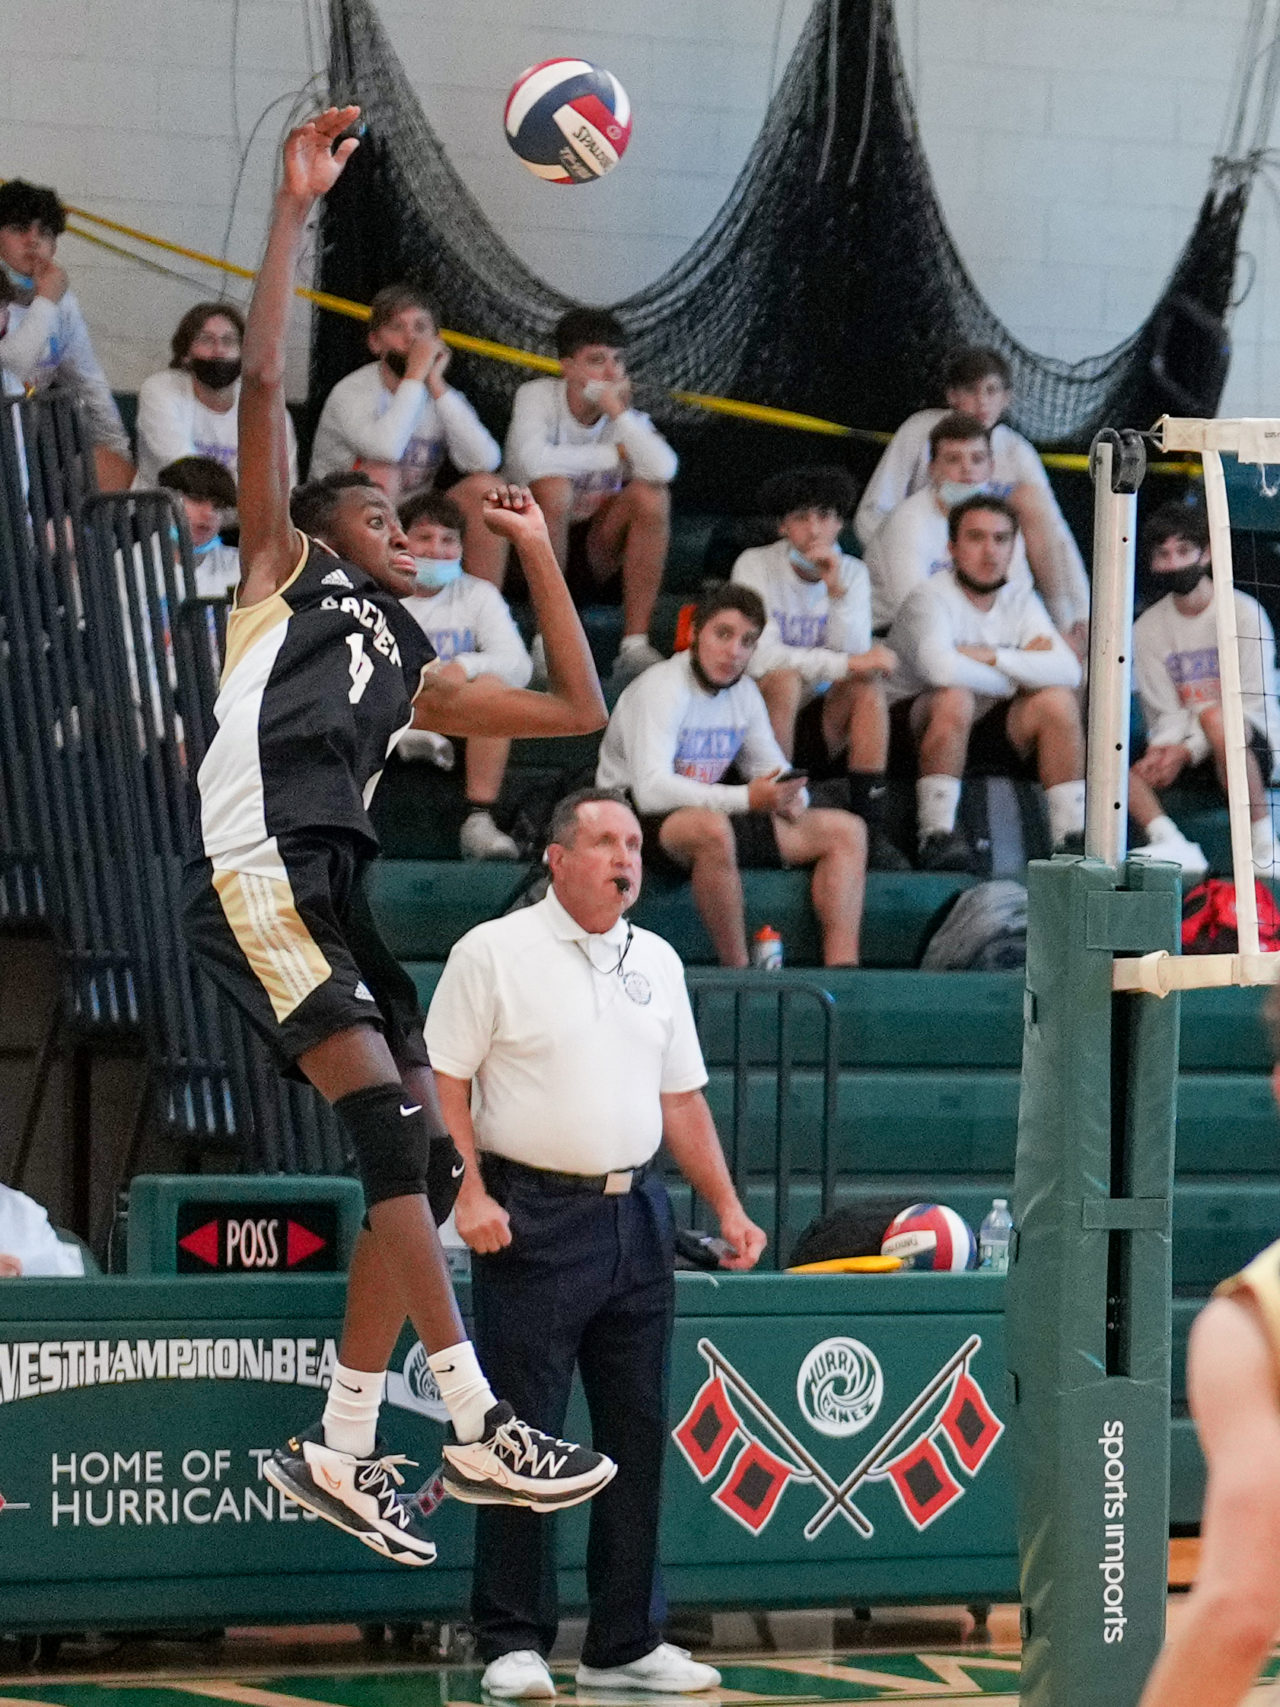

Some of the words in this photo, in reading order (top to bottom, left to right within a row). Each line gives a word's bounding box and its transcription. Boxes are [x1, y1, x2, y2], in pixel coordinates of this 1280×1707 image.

[573, 126, 614, 171] SPALD
[226, 1218, 279, 1268] POSS
[271, 1338, 338, 1390] BEA
[51, 1450, 164, 1485] HOME
[182, 1449, 232, 1484] OF
[1098, 1420, 1128, 1519] sports
[1098, 1523, 1128, 1645] imports
